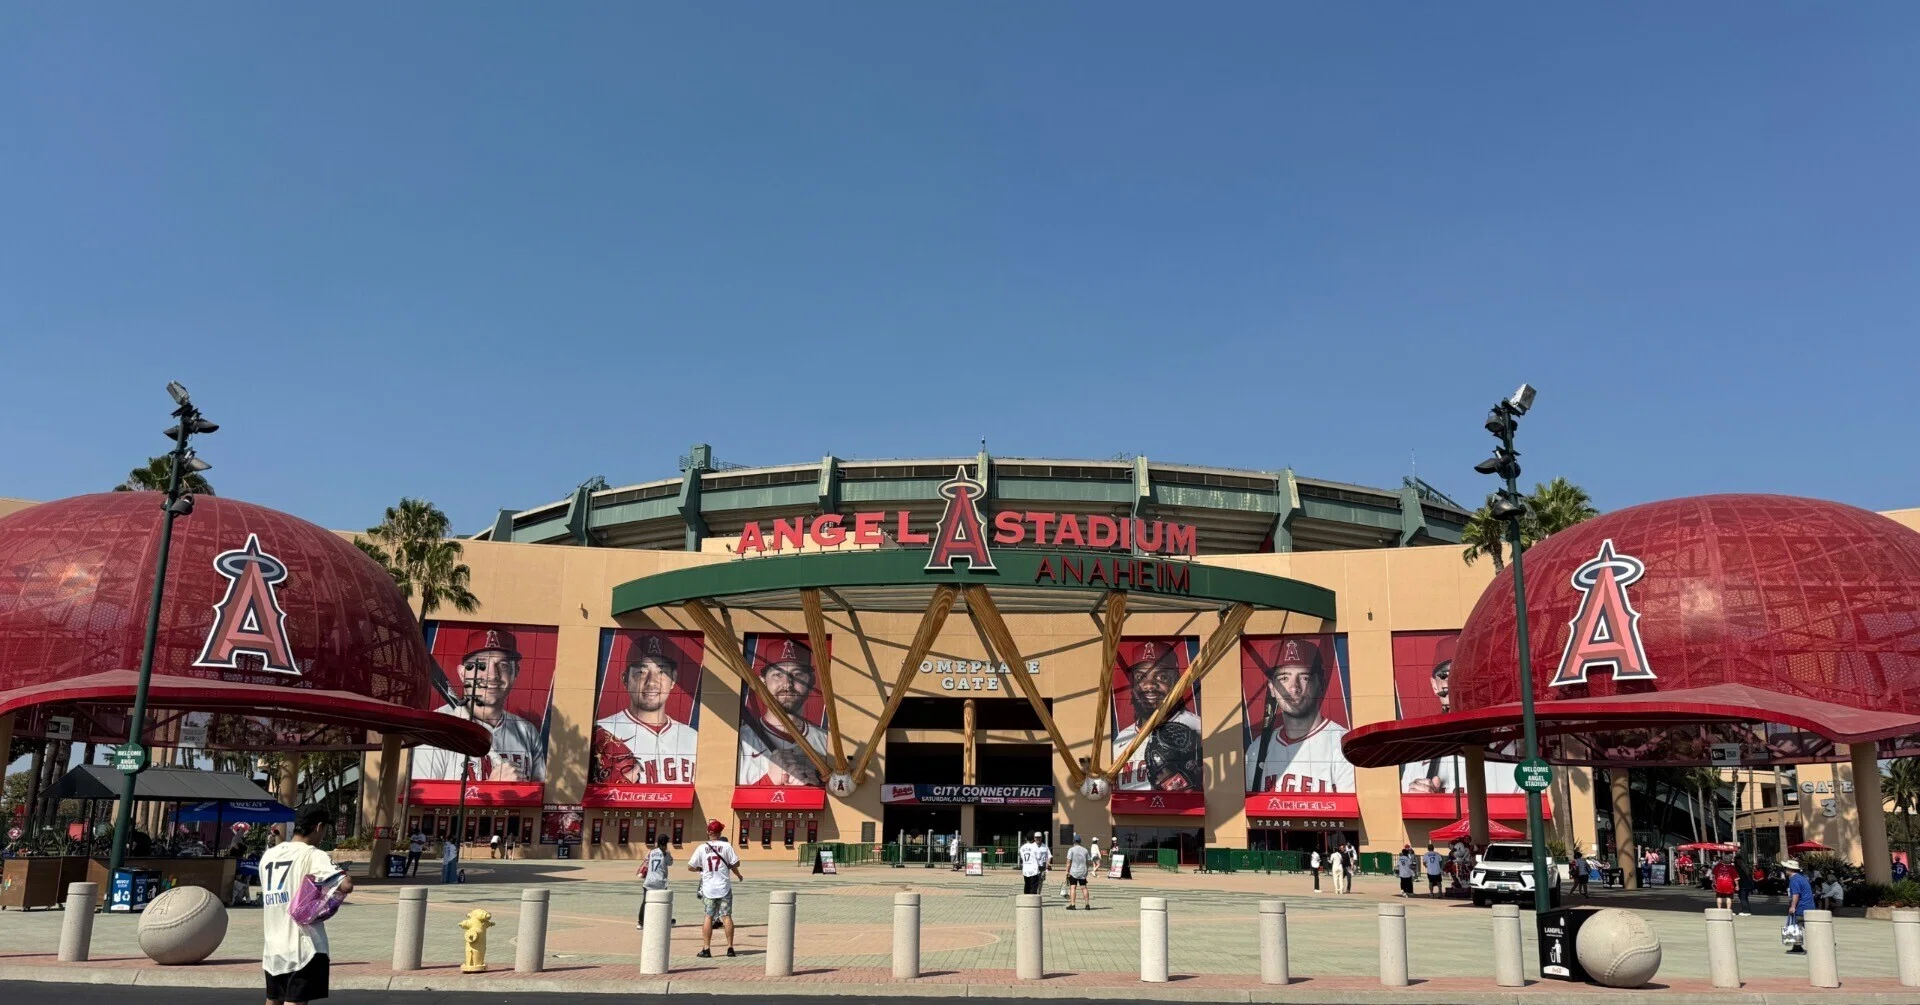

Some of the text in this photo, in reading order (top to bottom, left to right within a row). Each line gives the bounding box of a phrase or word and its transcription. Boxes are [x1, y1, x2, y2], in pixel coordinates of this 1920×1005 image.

[736, 511, 1198, 556] ANGEL STADIUM
[1035, 556, 1190, 591] ANAHEIM
[192, 533, 302, 675] A
[1549, 538, 1658, 687] A
[901, 660, 1040, 674] OMEPLAE
[941, 677, 999, 690] GATE
[604, 788, 673, 802] ANGELS
[933, 786, 1043, 797] CITY CONNECT HAT
[1267, 797, 1337, 811] ANGELS
[1820, 799, 1837, 818] 3
[1303, 820, 1345, 828] STORE
[652, 859, 662, 872] 17
[706, 856, 721, 872] 17
[265, 860, 293, 891] 17
[1543, 927, 1564, 935] LANDFILL
